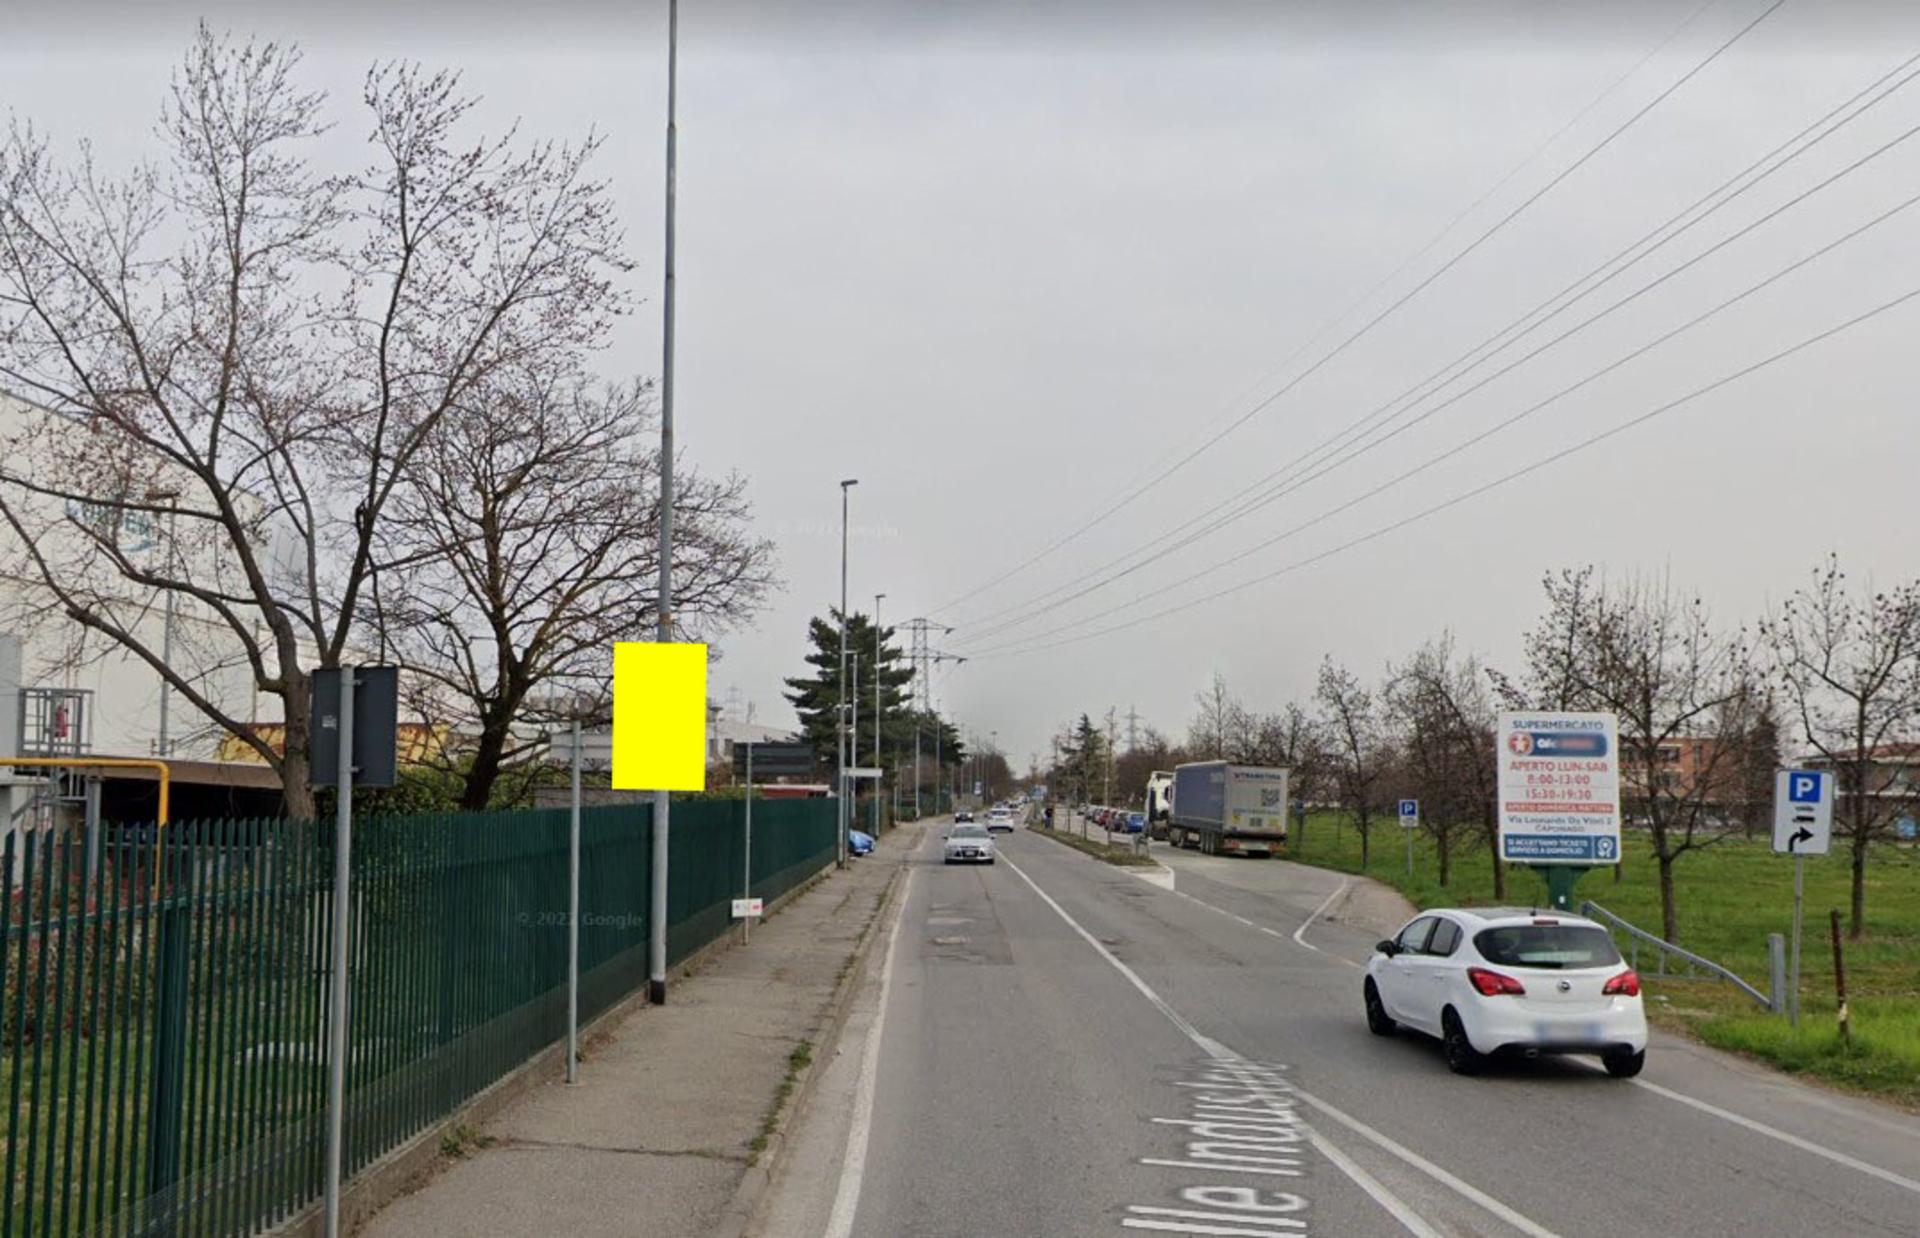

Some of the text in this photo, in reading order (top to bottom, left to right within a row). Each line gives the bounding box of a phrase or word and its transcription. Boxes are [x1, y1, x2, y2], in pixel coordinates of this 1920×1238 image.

[1512, 720, 1604, 730] SUPERMERCATO
[1510, 761, 1608, 773] APERTO LUN-SAB
[1796, 777, 1814, 798] P
